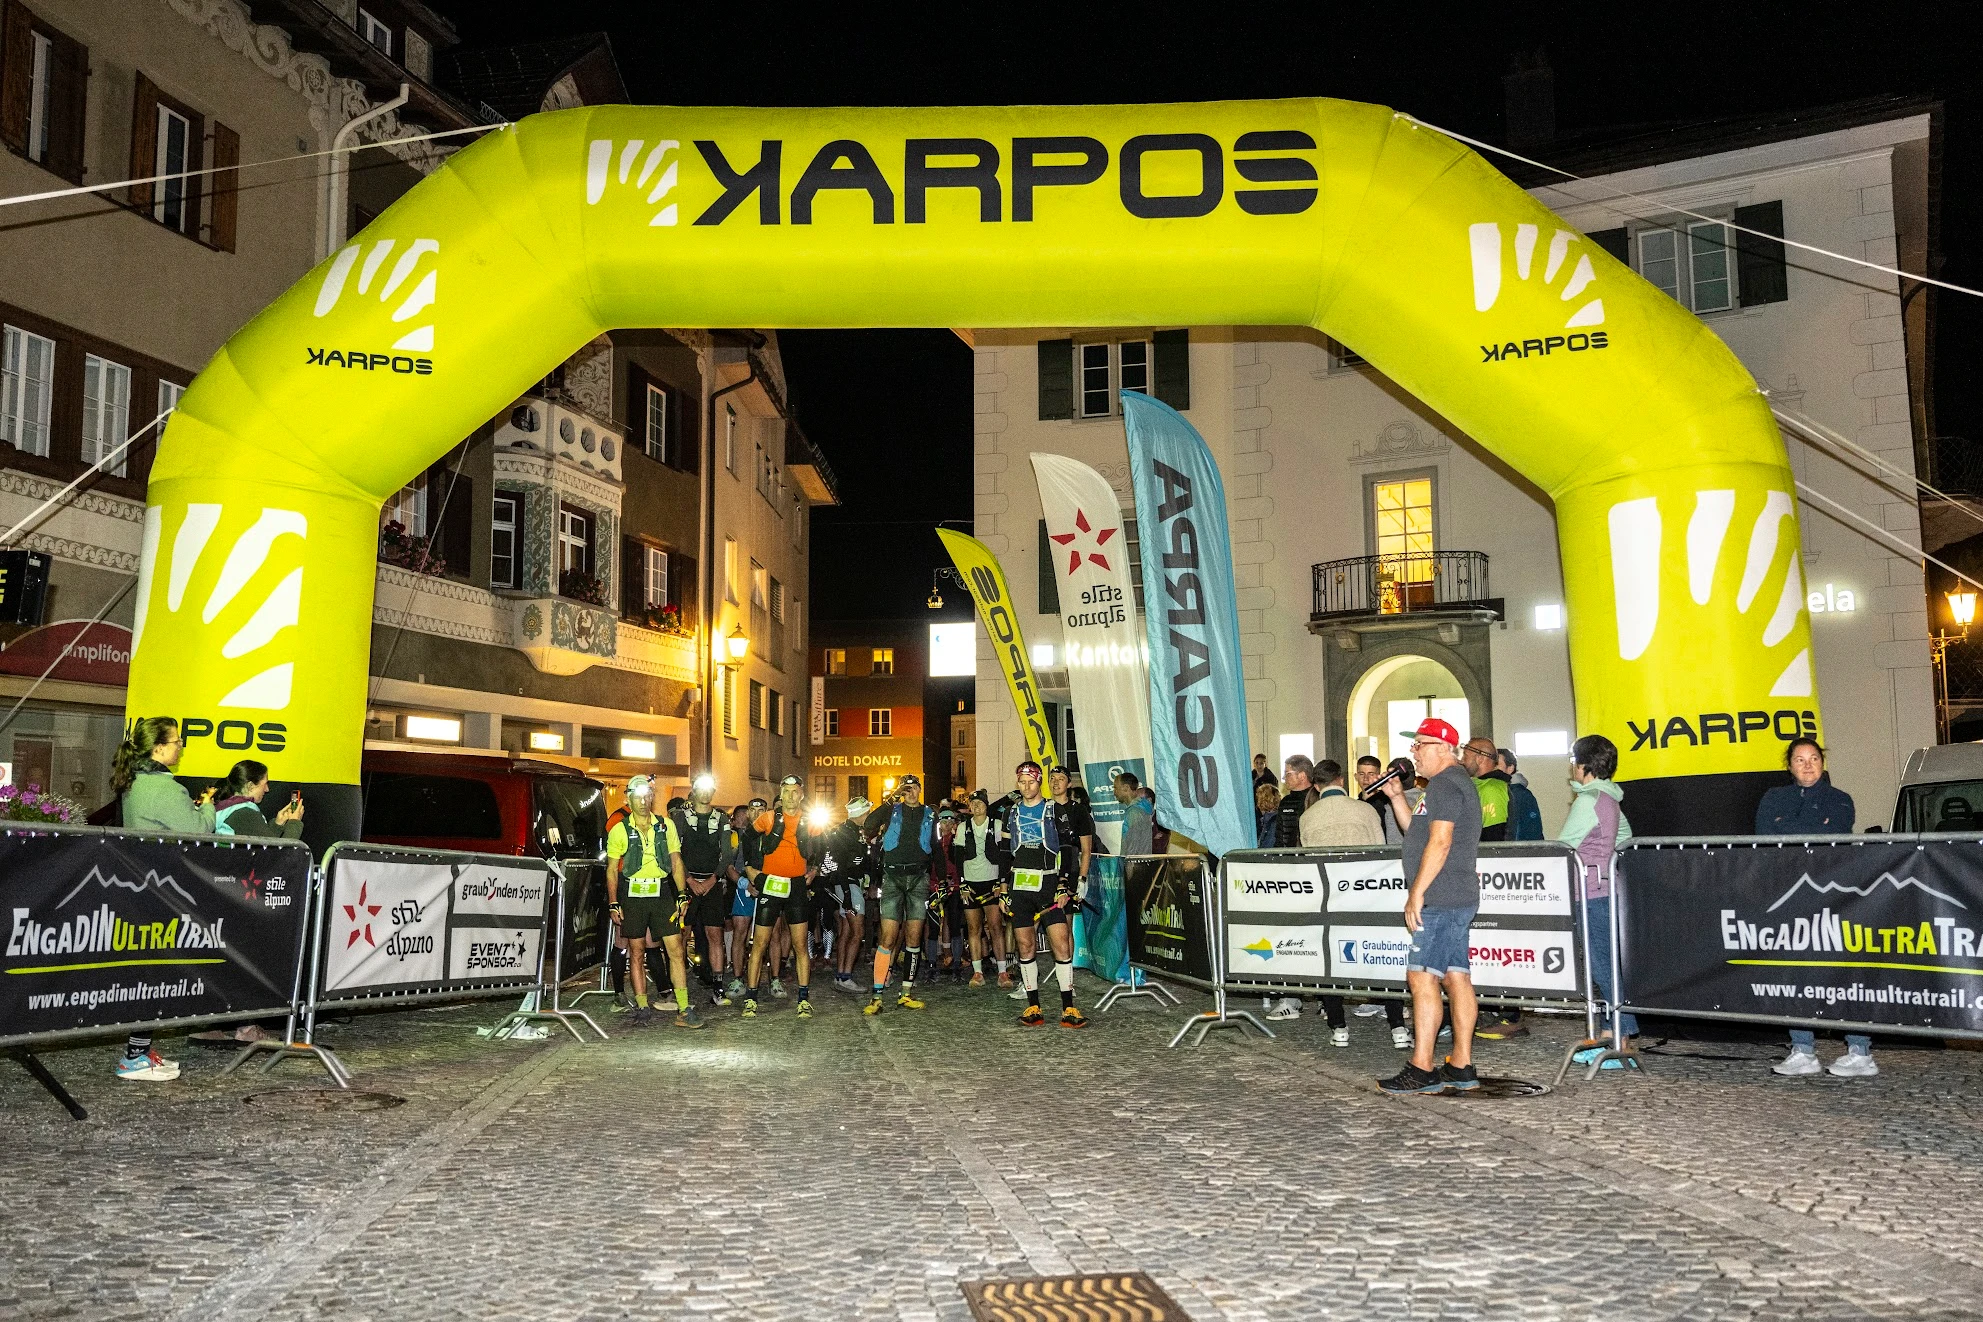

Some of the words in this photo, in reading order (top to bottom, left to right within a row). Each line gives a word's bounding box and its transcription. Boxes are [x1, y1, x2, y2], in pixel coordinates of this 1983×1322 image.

[692, 130, 1319, 226] KARPOS
[1480, 332, 1609, 362] KARPOS
[305, 348, 433, 375] KARPOS
[125, 717, 287, 752] POS
[1626, 710, 1818, 752] KARPOS
[814, 755, 850, 766] HOTEL
[853, 755, 902, 766] DONATZ
[266, 876, 286, 890] stile
[519, 885, 541, 903] Sport
[1244, 880, 1314, 893] KARPOS
[264, 893, 291, 910] alpino
[1482, 893, 1506, 901] Unsere
[1507, 893, 1534, 903] Energie
[1535, 893, 1546, 901] für
[386, 931, 433, 962] alpino
[470, 943, 510, 957] EVENT
[28, 978, 205, 1011] www.engadinultratrail.ch
